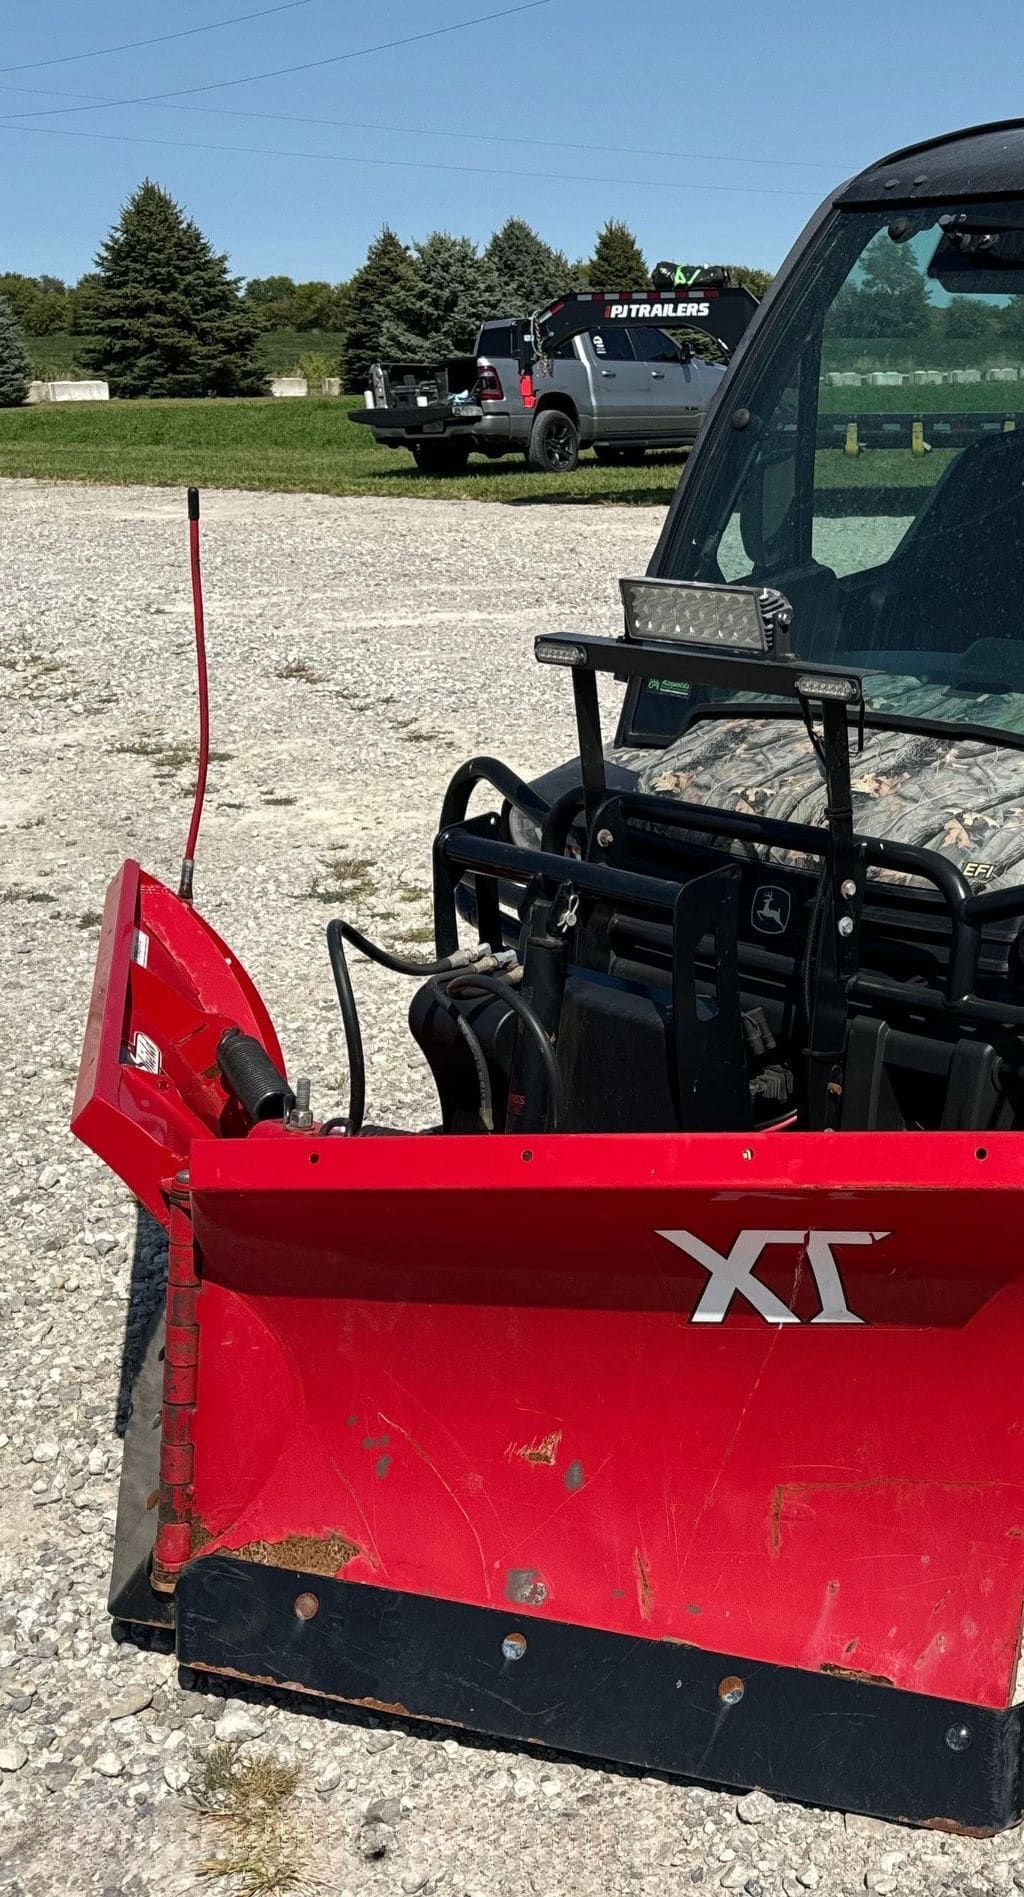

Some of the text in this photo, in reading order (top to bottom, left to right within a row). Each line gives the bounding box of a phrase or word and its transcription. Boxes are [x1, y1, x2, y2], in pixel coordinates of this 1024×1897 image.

[610, 303, 710, 318] PJ TRAILERS
[963, 862, 994, 878] EFI
[653, 1229, 894, 1323] XT
